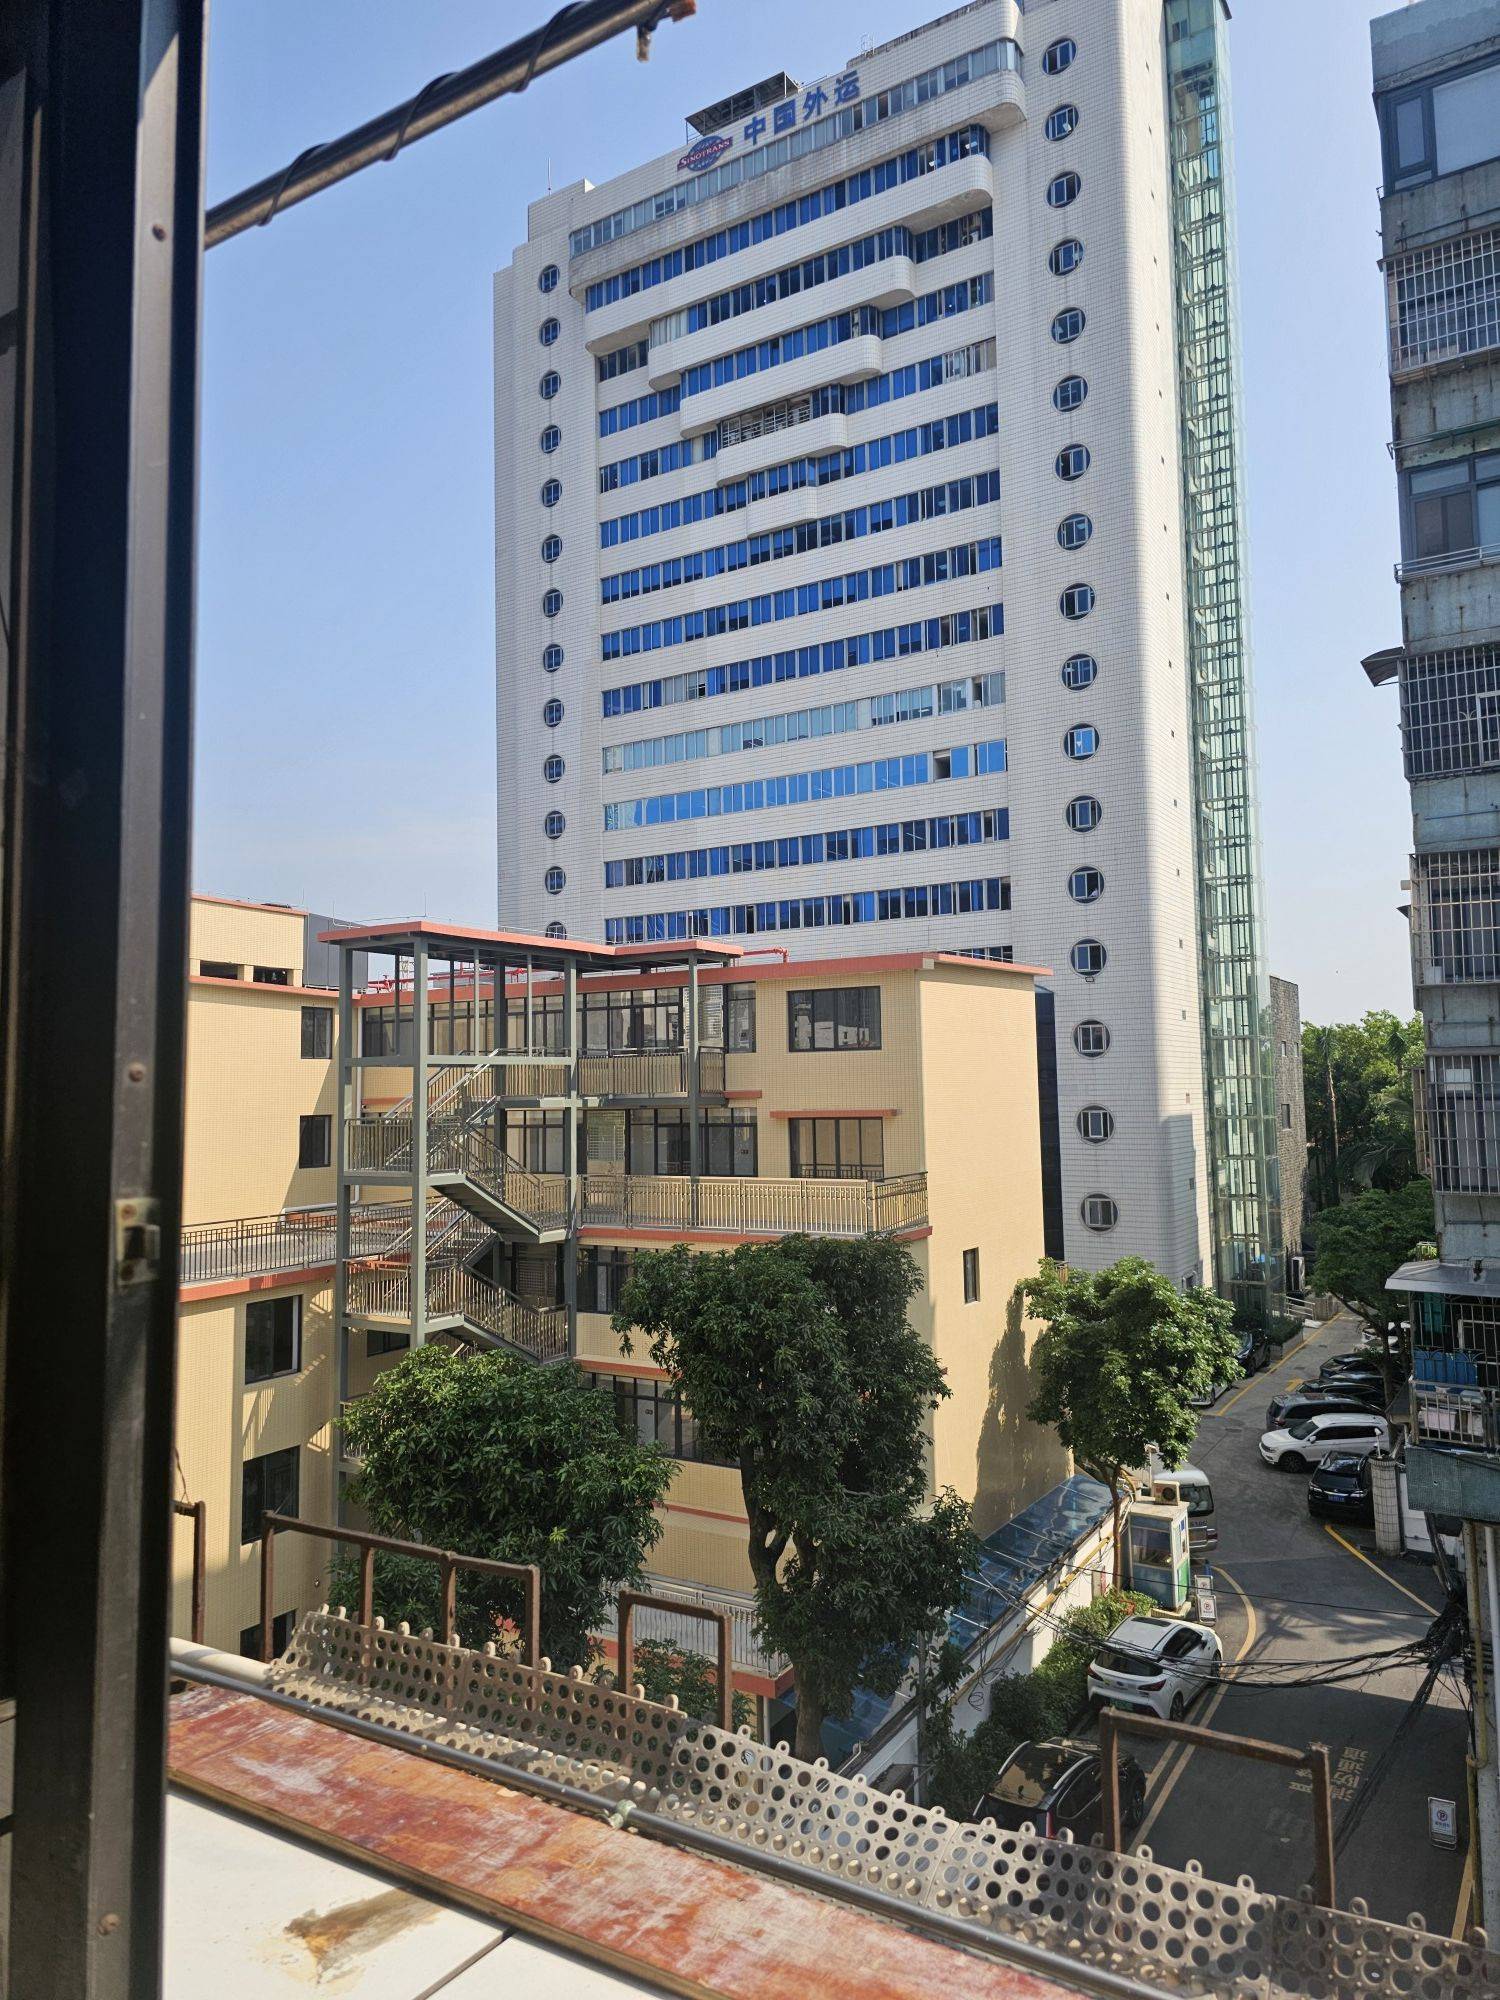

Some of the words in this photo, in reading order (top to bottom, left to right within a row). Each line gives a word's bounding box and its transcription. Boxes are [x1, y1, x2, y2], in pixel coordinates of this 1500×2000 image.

[743, 70, 860, 145] 中国外运
[679, 138, 731, 169] SINOTRANS
